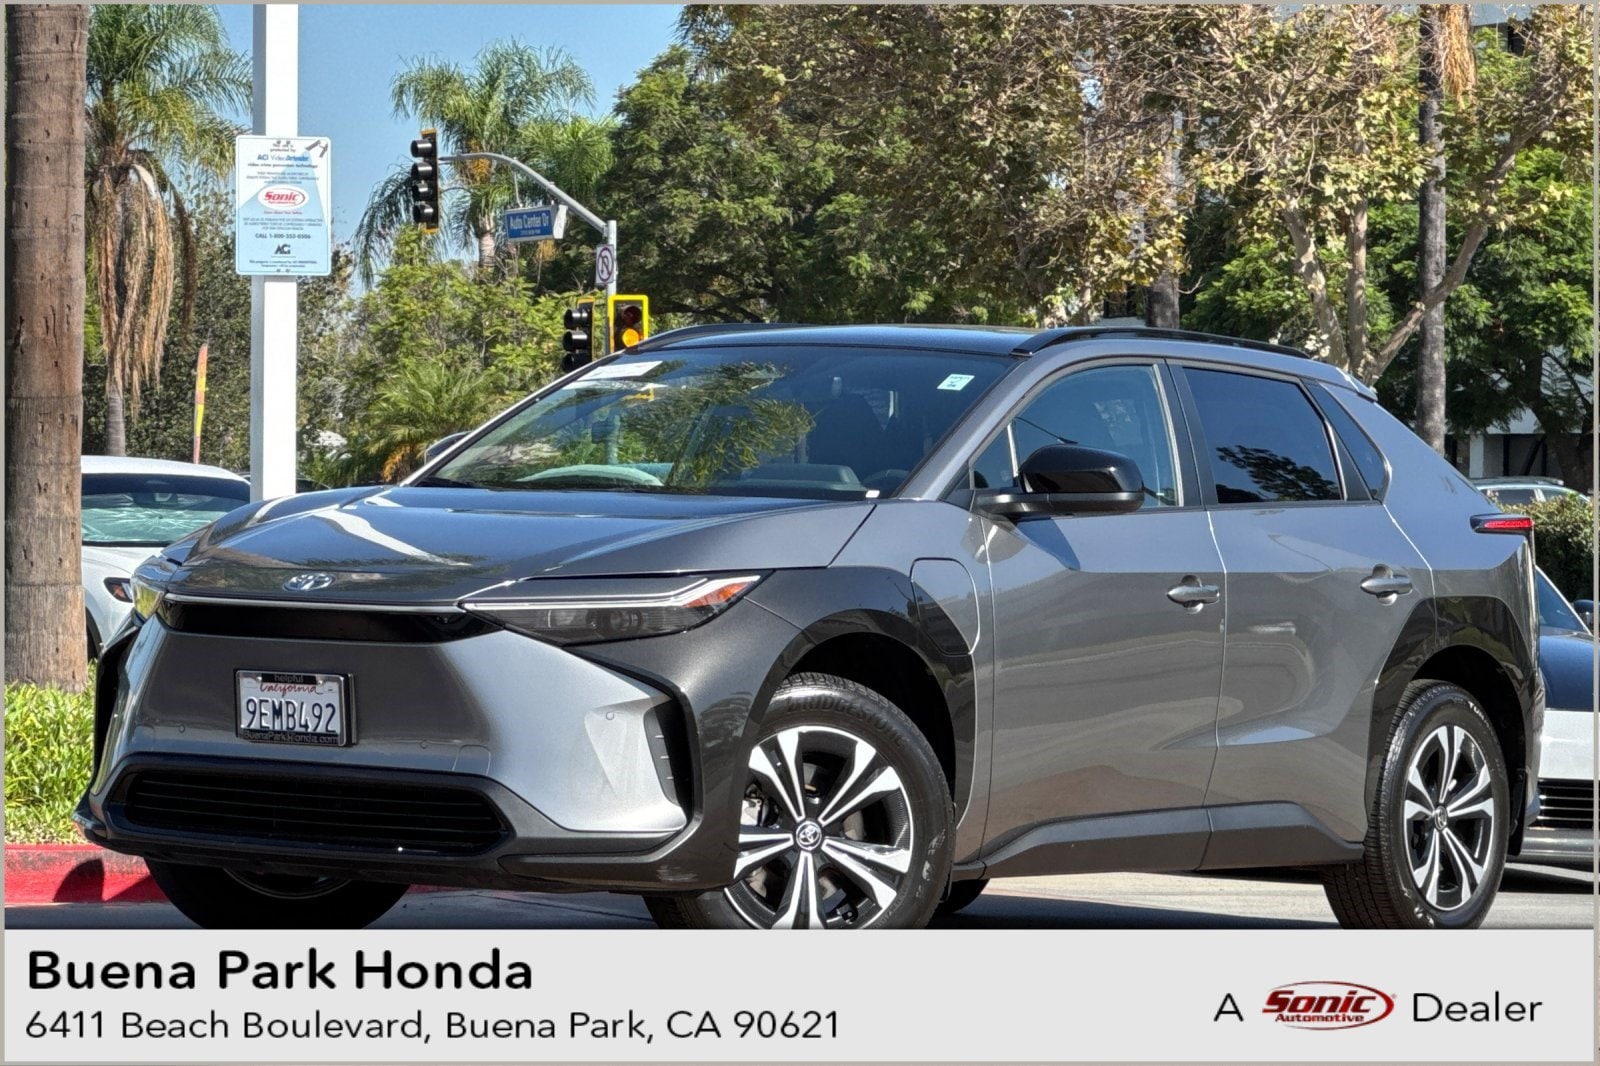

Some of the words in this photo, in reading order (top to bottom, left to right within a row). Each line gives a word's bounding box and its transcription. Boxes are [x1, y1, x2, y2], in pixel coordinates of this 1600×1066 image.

[264, 191, 300, 201] Sonic
[510, 215, 523, 230] Auto
[523, 213, 541, 229] Center
[541, 212, 549, 227] Dr
[274, 674, 303, 683] helpful
[260, 683, 323, 697] California
[246, 698, 337, 733] 9EMB492
[243, 730, 339, 744] BuenaParkHonda.com
